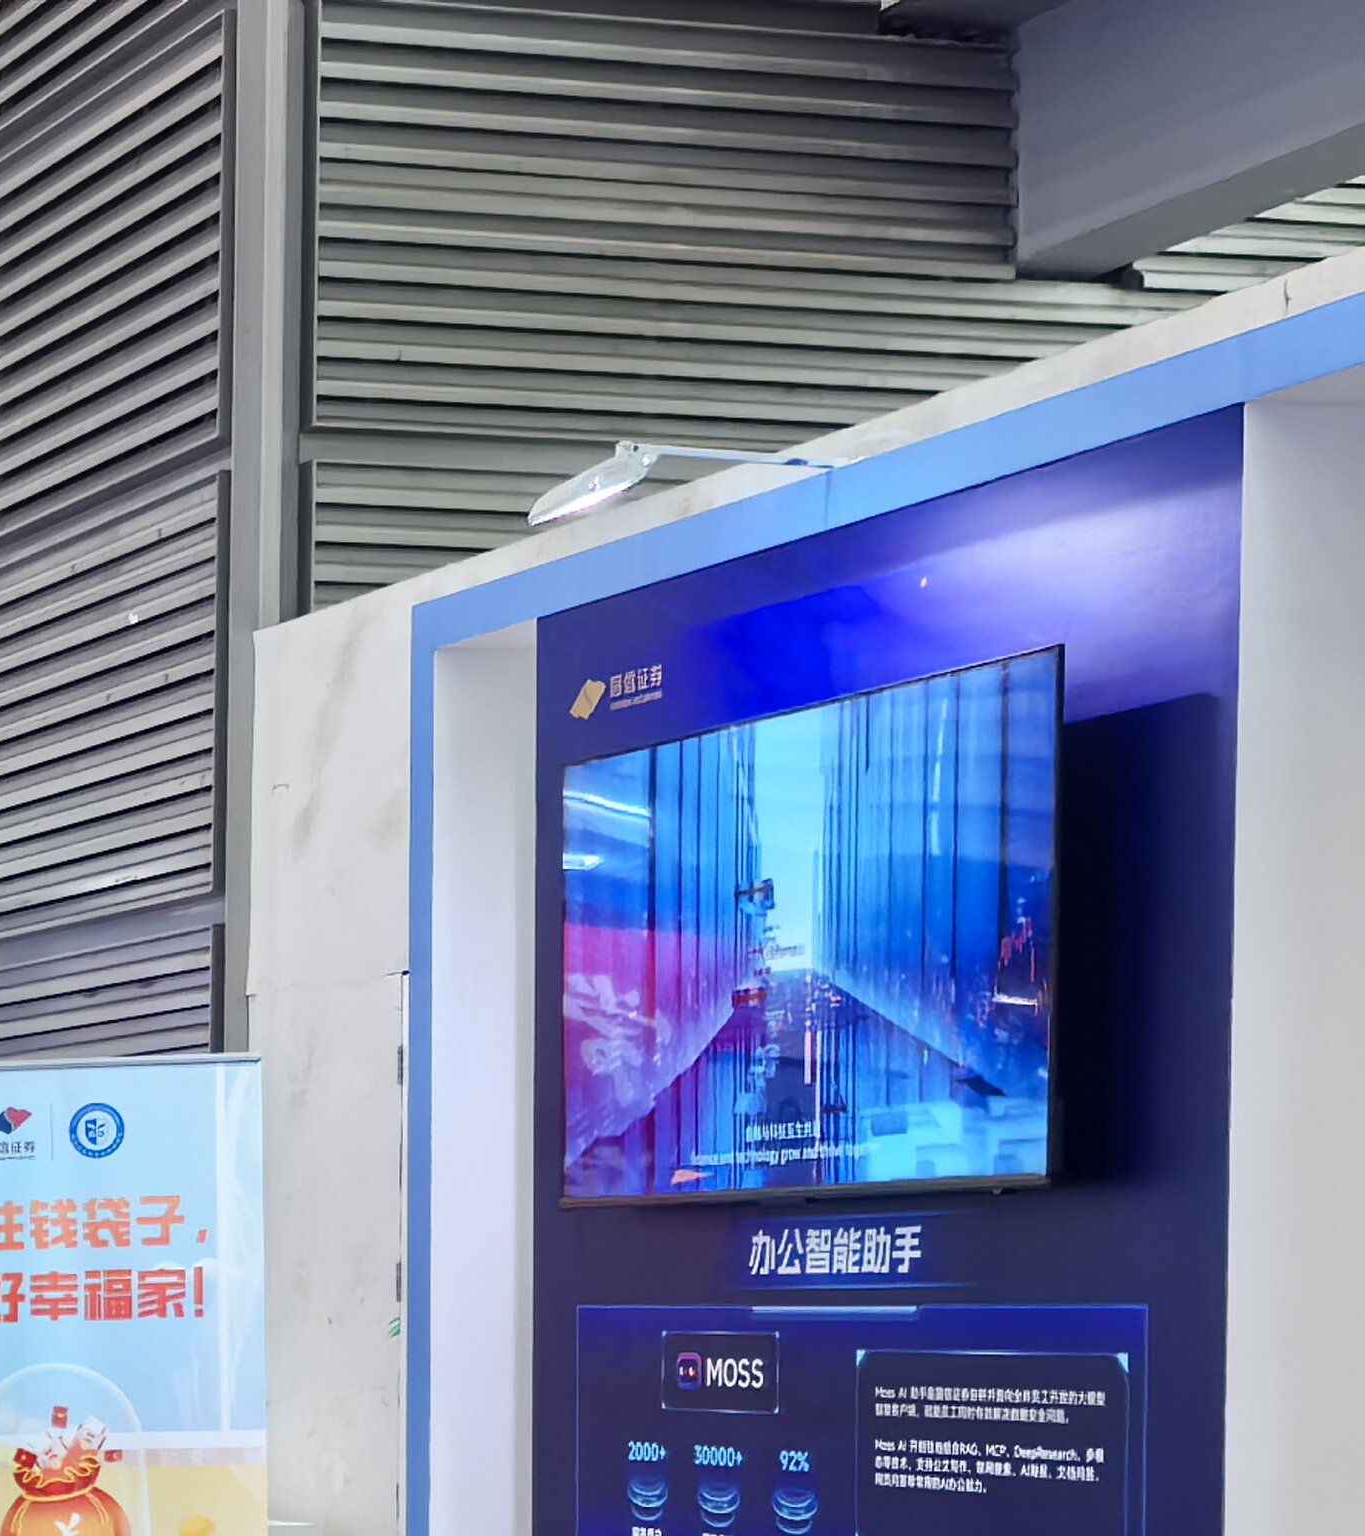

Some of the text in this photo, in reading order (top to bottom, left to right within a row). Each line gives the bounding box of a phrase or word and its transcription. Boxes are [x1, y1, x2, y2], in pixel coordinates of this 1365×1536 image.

[748, 1225, 923, 1276] 办公智能助手
[706, 1357, 764, 1389] MOSS
[627, 1441, 667, 1461] 2000+
[779, 1450, 810, 1472] 92%
